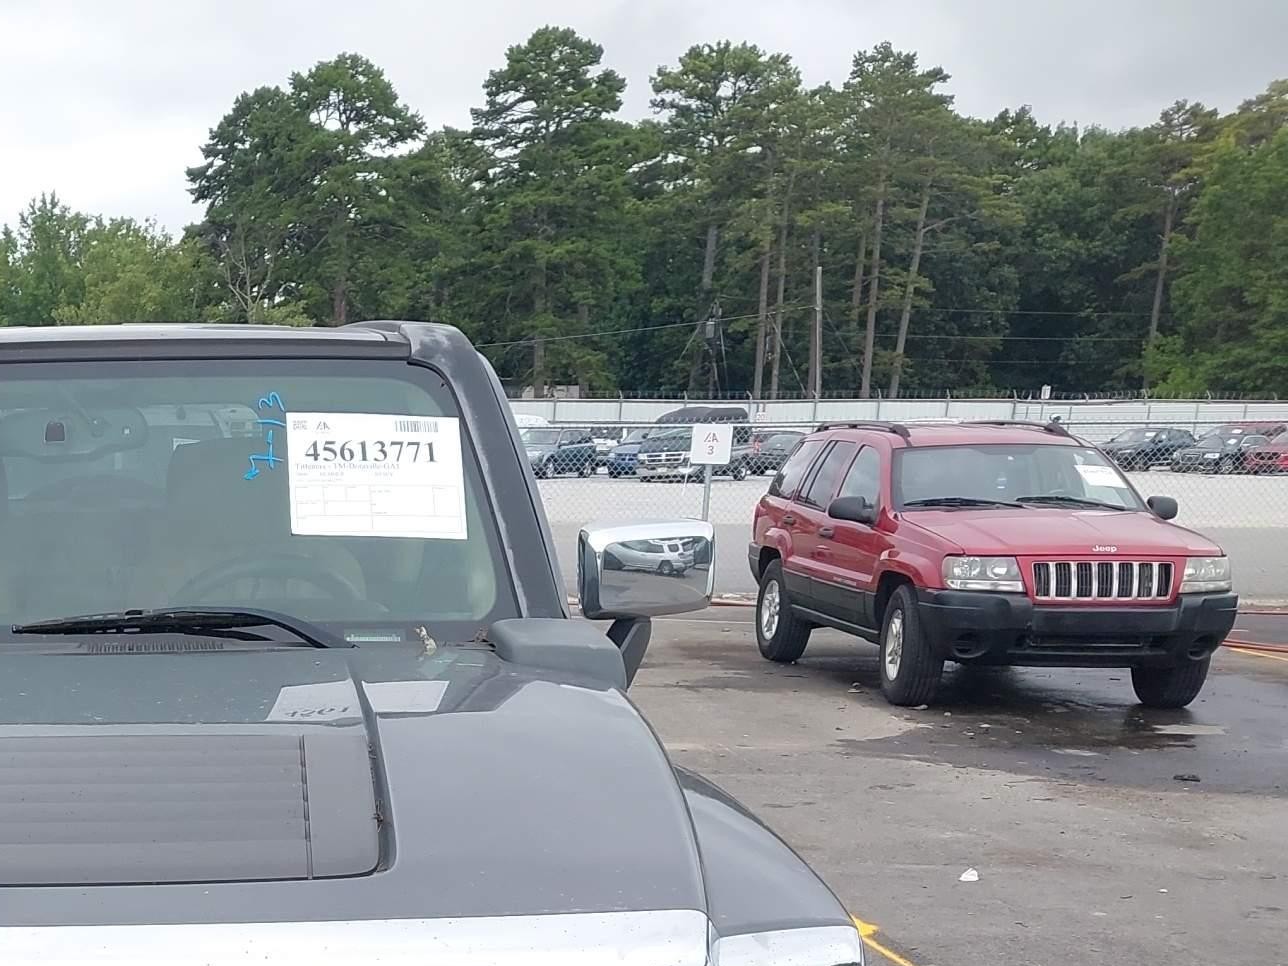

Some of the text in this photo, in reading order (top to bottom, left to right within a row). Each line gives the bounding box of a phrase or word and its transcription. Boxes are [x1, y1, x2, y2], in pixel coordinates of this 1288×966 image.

[304, 440, 439, 463] 45613771
[707, 445, 714, 456] 3
[1092, 544, 1118, 553] Jeep
